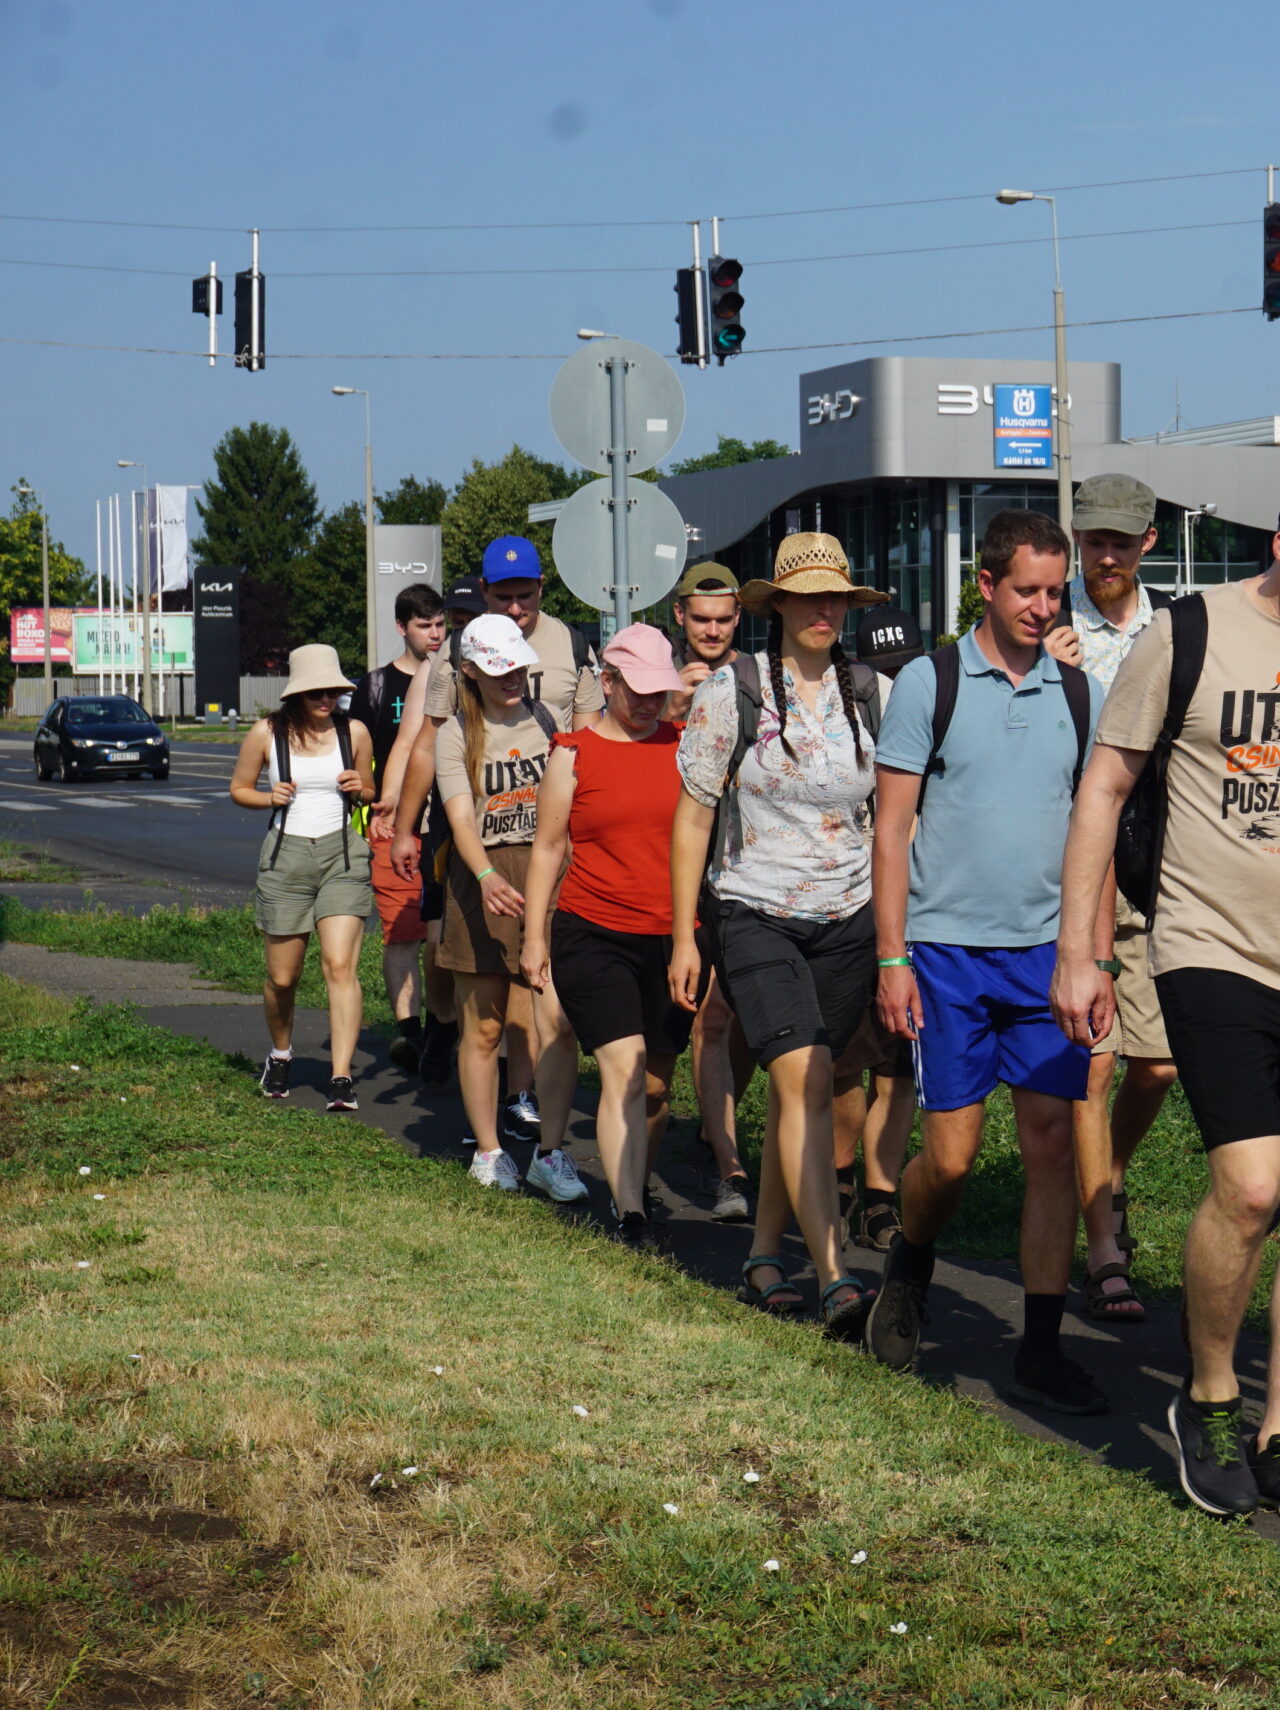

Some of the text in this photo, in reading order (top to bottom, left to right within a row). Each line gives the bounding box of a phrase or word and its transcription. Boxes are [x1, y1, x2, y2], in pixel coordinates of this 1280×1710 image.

[1000, 417, 1048, 428] Husqvarna
[378, 562, 427, 574] BYD
[200, 582, 233, 592] KIA
